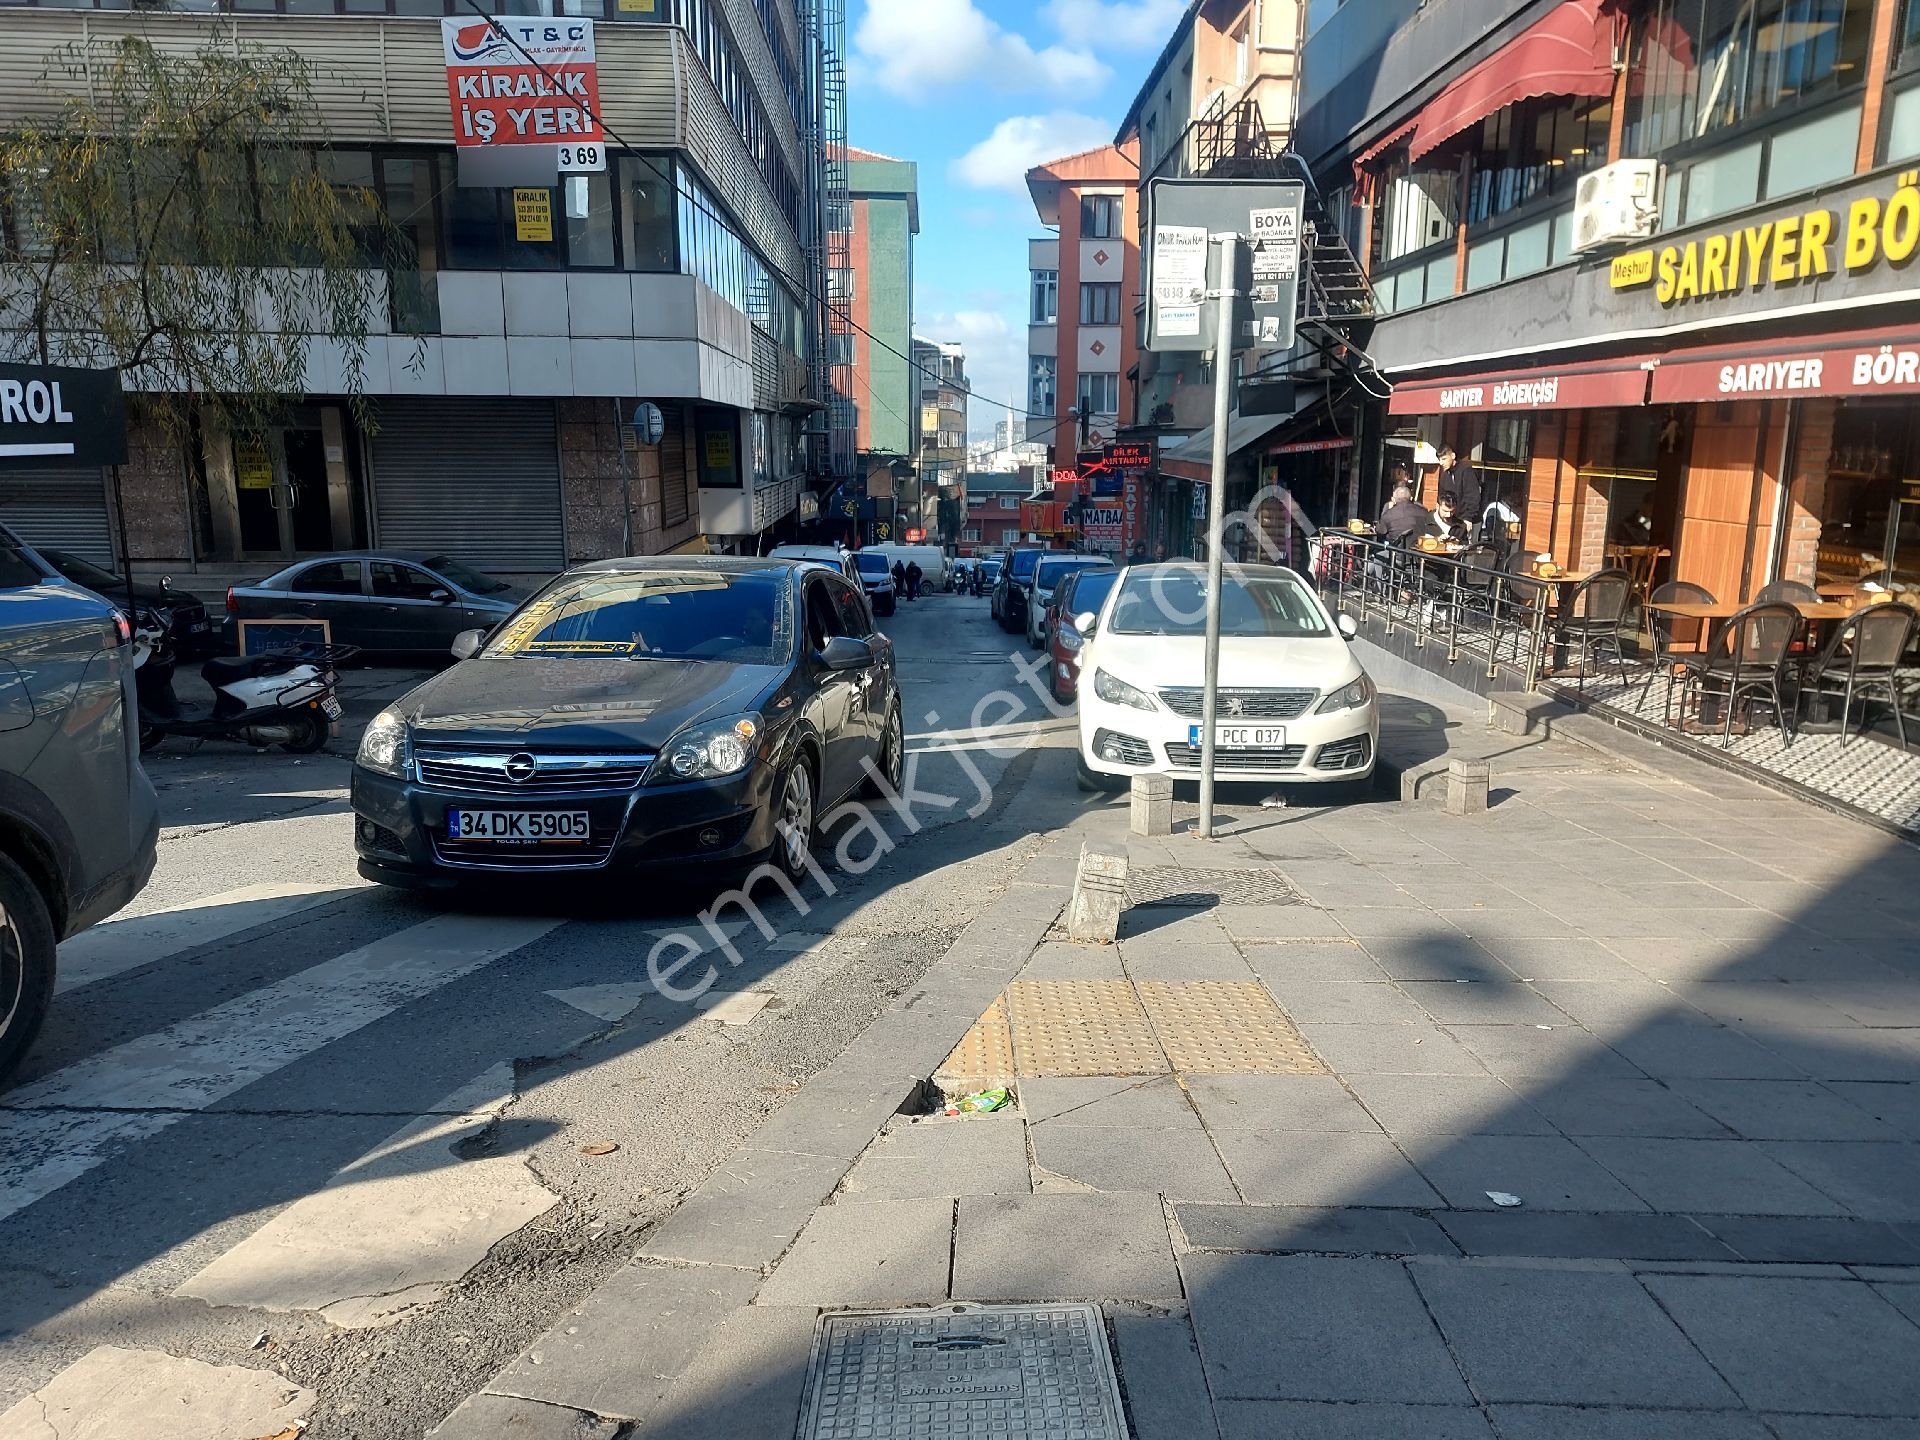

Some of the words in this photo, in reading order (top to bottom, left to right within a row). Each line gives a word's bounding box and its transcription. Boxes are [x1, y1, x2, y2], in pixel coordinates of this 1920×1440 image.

[519, 28, 535, 42] T
[543, 26, 561, 42] &
[568, 26, 584, 41] C
[457, 69, 589, 99] KİRALIK
[461, 103, 497, 143] İŞ
[506, 100, 593, 136] YERİ
[560, 148, 572, 165] 3
[576, 147, 598, 165] 69
[516, 191, 548, 202] KİRALIK
[1255, 214, 1292, 228] BOYA
[1613, 259, 1649, 281] Meşhur
[1655, 208, 1832, 303] SARIYER
[1844, 169, 1920, 269] BÖ
[1718, 358, 1823, 393] SARIYER
[1852, 345, 1920, 385] BÖR
[0, 379, 74, 424] ROL
[1439, 387, 1483, 408] SARIYER
[1493, 377, 1559, 408] BÖREKÇİSİ
[1103, 455, 1150, 465] KIRTASİYE
[1113, 447, 1139, 456] DİLEK
[1223, 729, 1248, 743] PCC
[1255, 729, 1281, 743] 037
[460, 813, 488, 836] 34
[491, 813, 525, 836] DK
[528, 813, 588, 836] 5905
[900, 1383, 1020, 1397] SUPERONLINE
